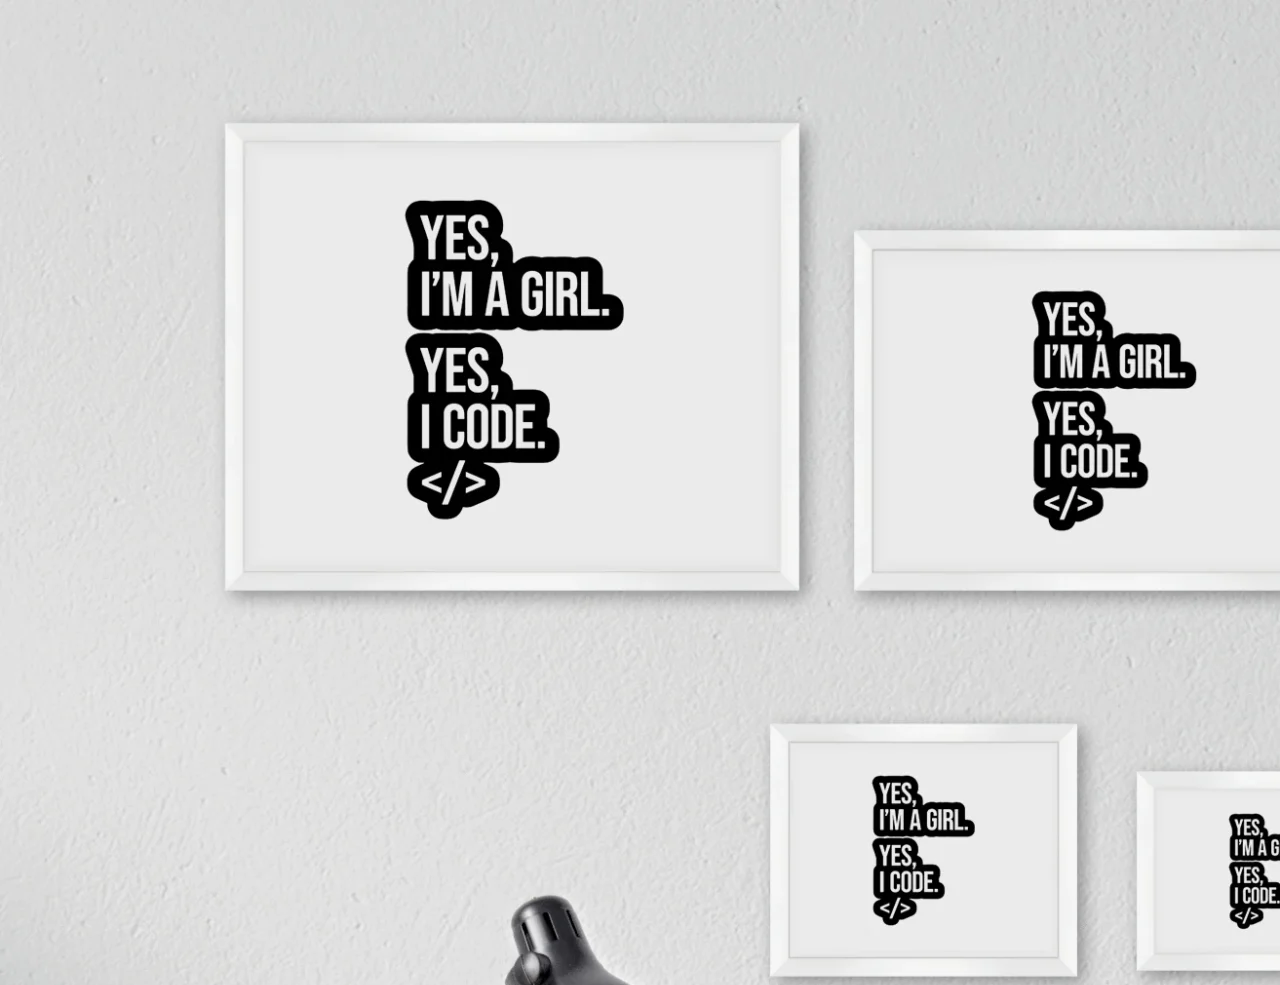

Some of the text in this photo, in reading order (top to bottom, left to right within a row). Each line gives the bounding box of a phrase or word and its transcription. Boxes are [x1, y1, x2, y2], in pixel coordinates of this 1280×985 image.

[420, 214, 499, 266] YES,
[421, 270, 610, 317] I'M A GIRL.
[1043, 302, 1102, 341] YES,
[420, 347, 499, 399] YES,
[1044, 344, 1185, 379] I'M A GIRL.
[421, 403, 545, 449] I CODE.
[1043, 401, 1102, 441] YES,
[1044, 443, 1137, 479] I CODE.
[879, 783, 916, 807] YES,
[880, 809, 968, 830] I'M A GIRL.
[1234, 819, 1263, 838] YES,
[879, 845, 916, 869] YES,
[1235, 839, 1253, 856] I'M
[1258, 839, 1266, 856] A
[879, 870, 938, 893] I CODE.
[1234, 867, 1263, 886] YES,
[1234, 887, 1280, 904] I CODE.
